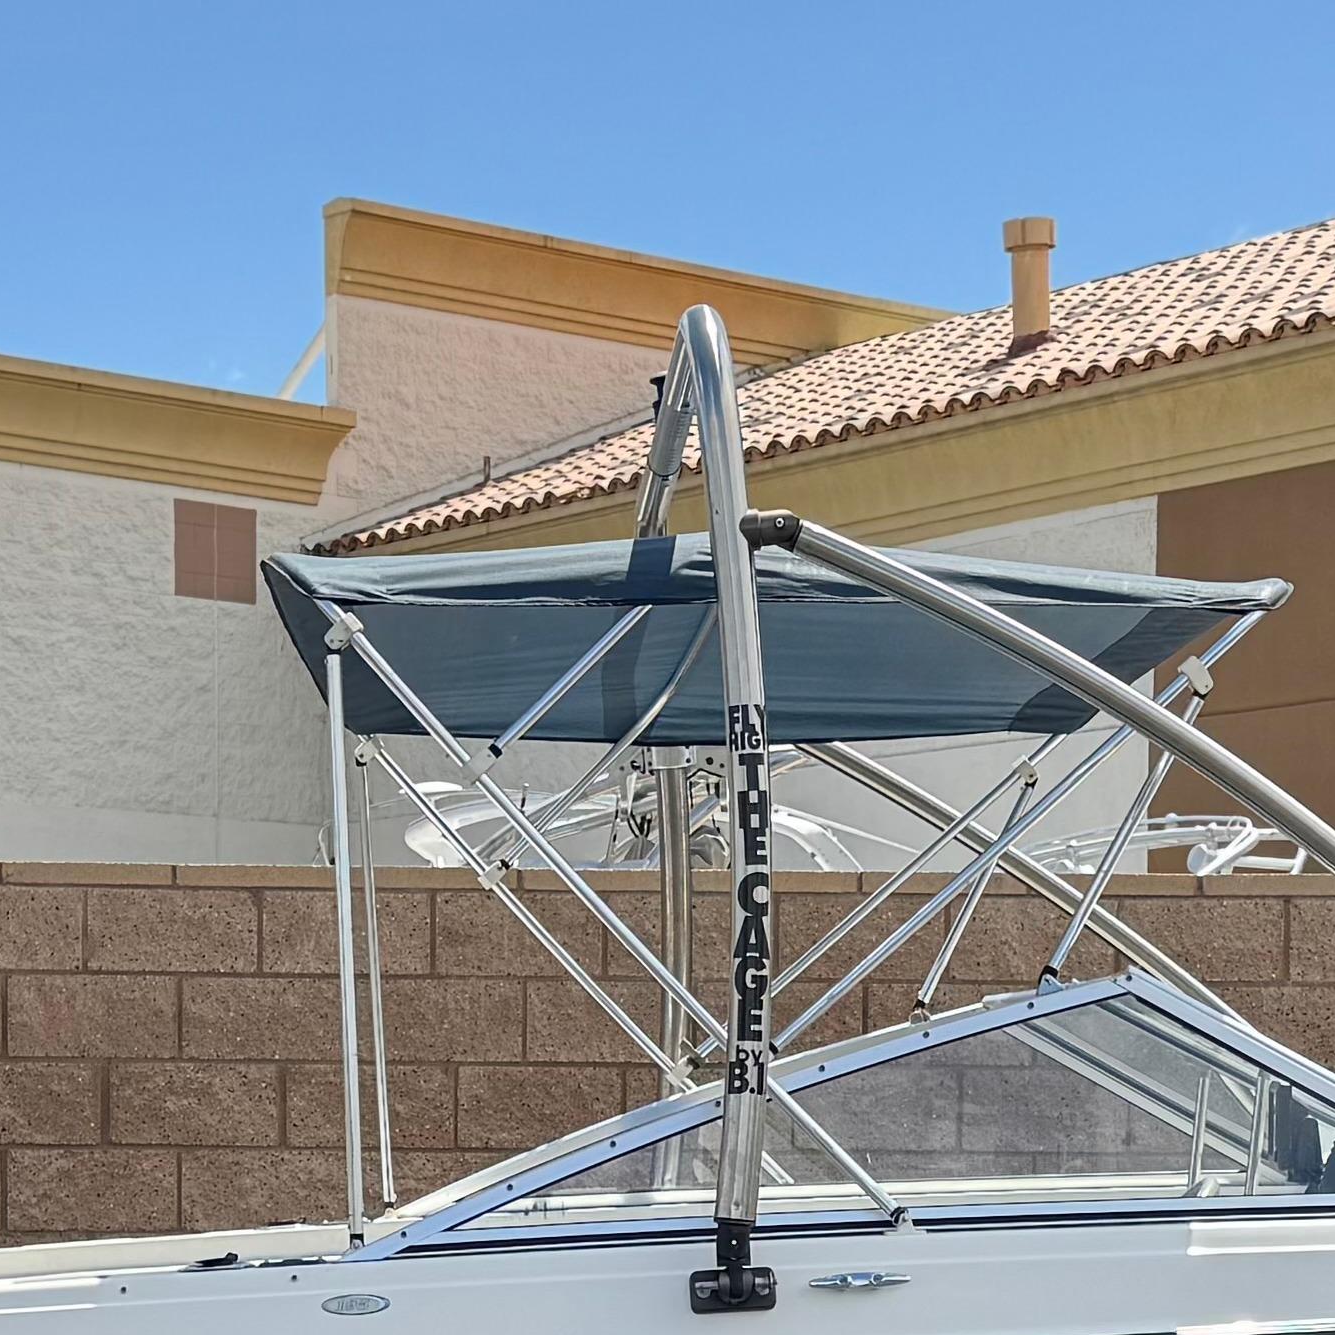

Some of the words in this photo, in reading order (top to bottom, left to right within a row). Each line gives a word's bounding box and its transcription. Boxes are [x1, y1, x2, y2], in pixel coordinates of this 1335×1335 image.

[737, 752, 768, 866] THE
[733, 871, 770, 1042] CAGE
[735, 1044, 763, 1067] by
